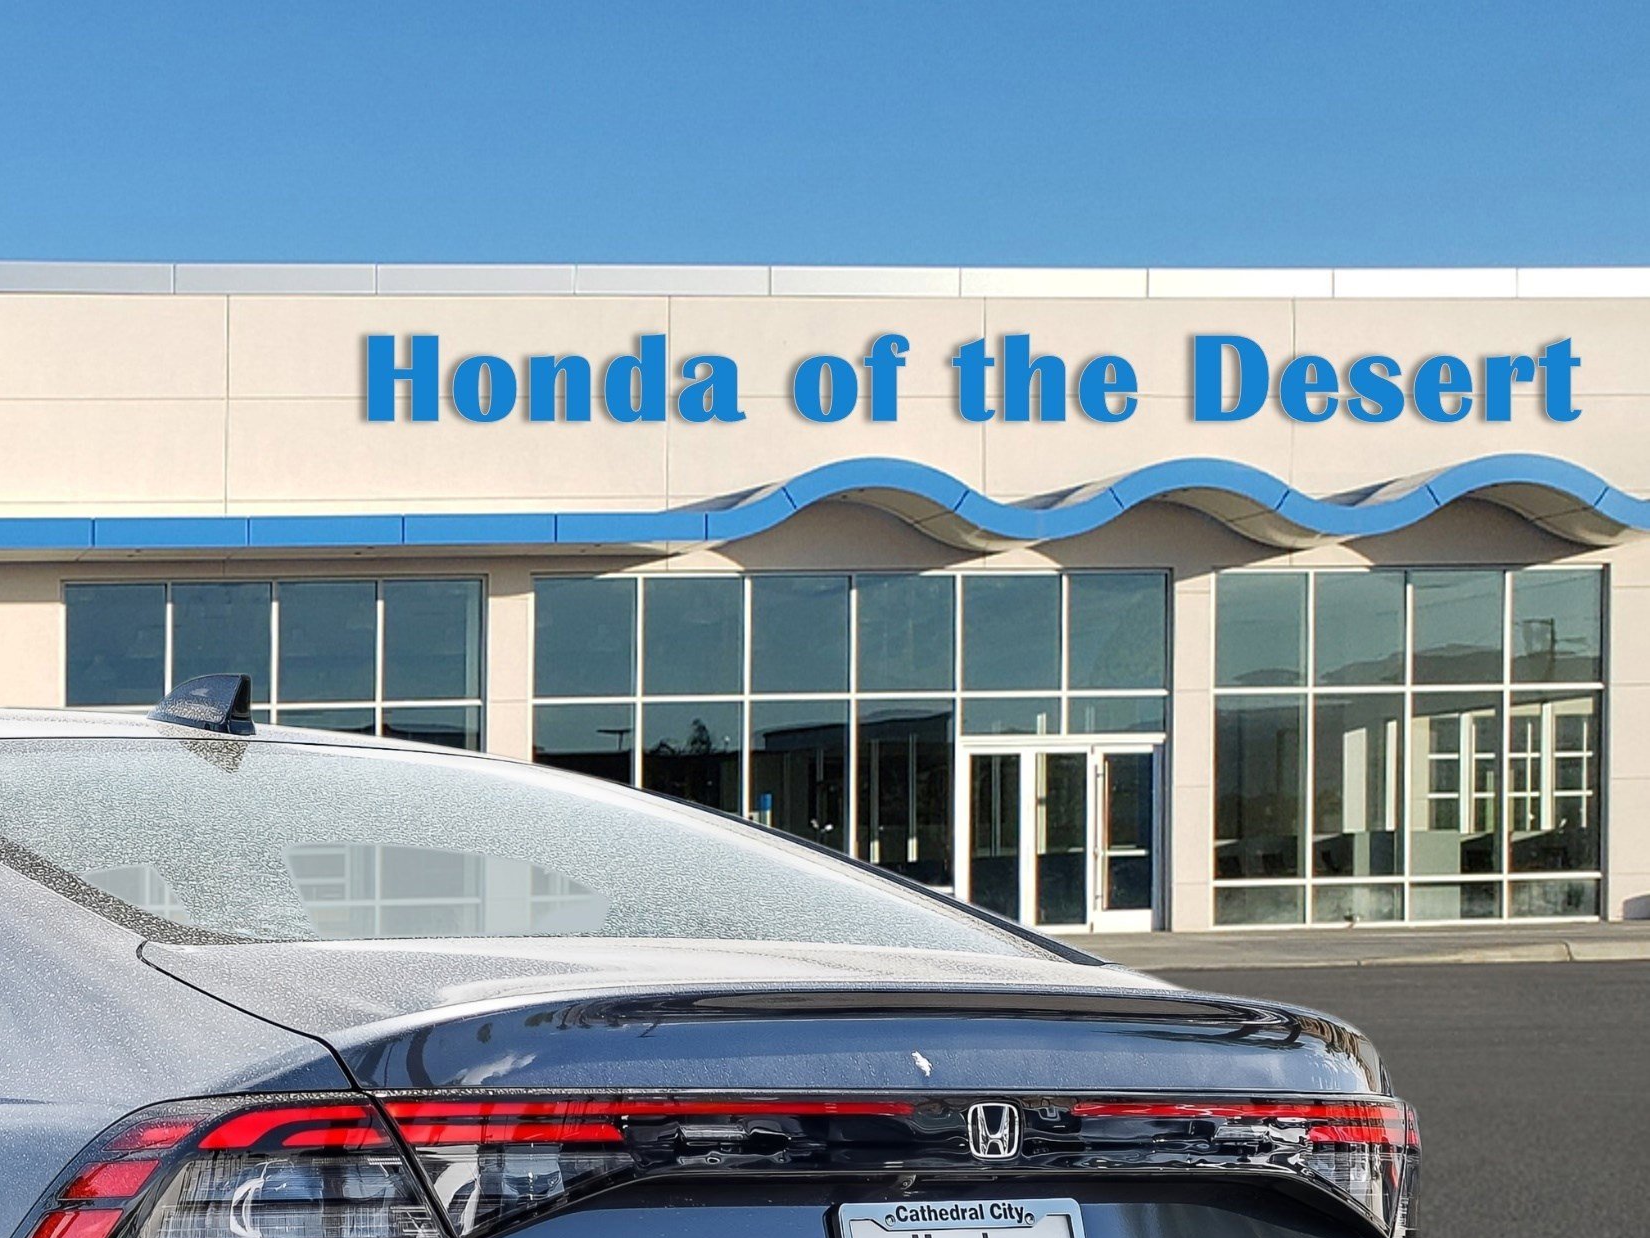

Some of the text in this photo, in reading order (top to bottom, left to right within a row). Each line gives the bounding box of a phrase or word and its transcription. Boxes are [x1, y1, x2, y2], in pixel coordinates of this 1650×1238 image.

[366, 333, 1582, 423] Honda of the Desert
[895, 1202, 1025, 1224] Cathedral City
